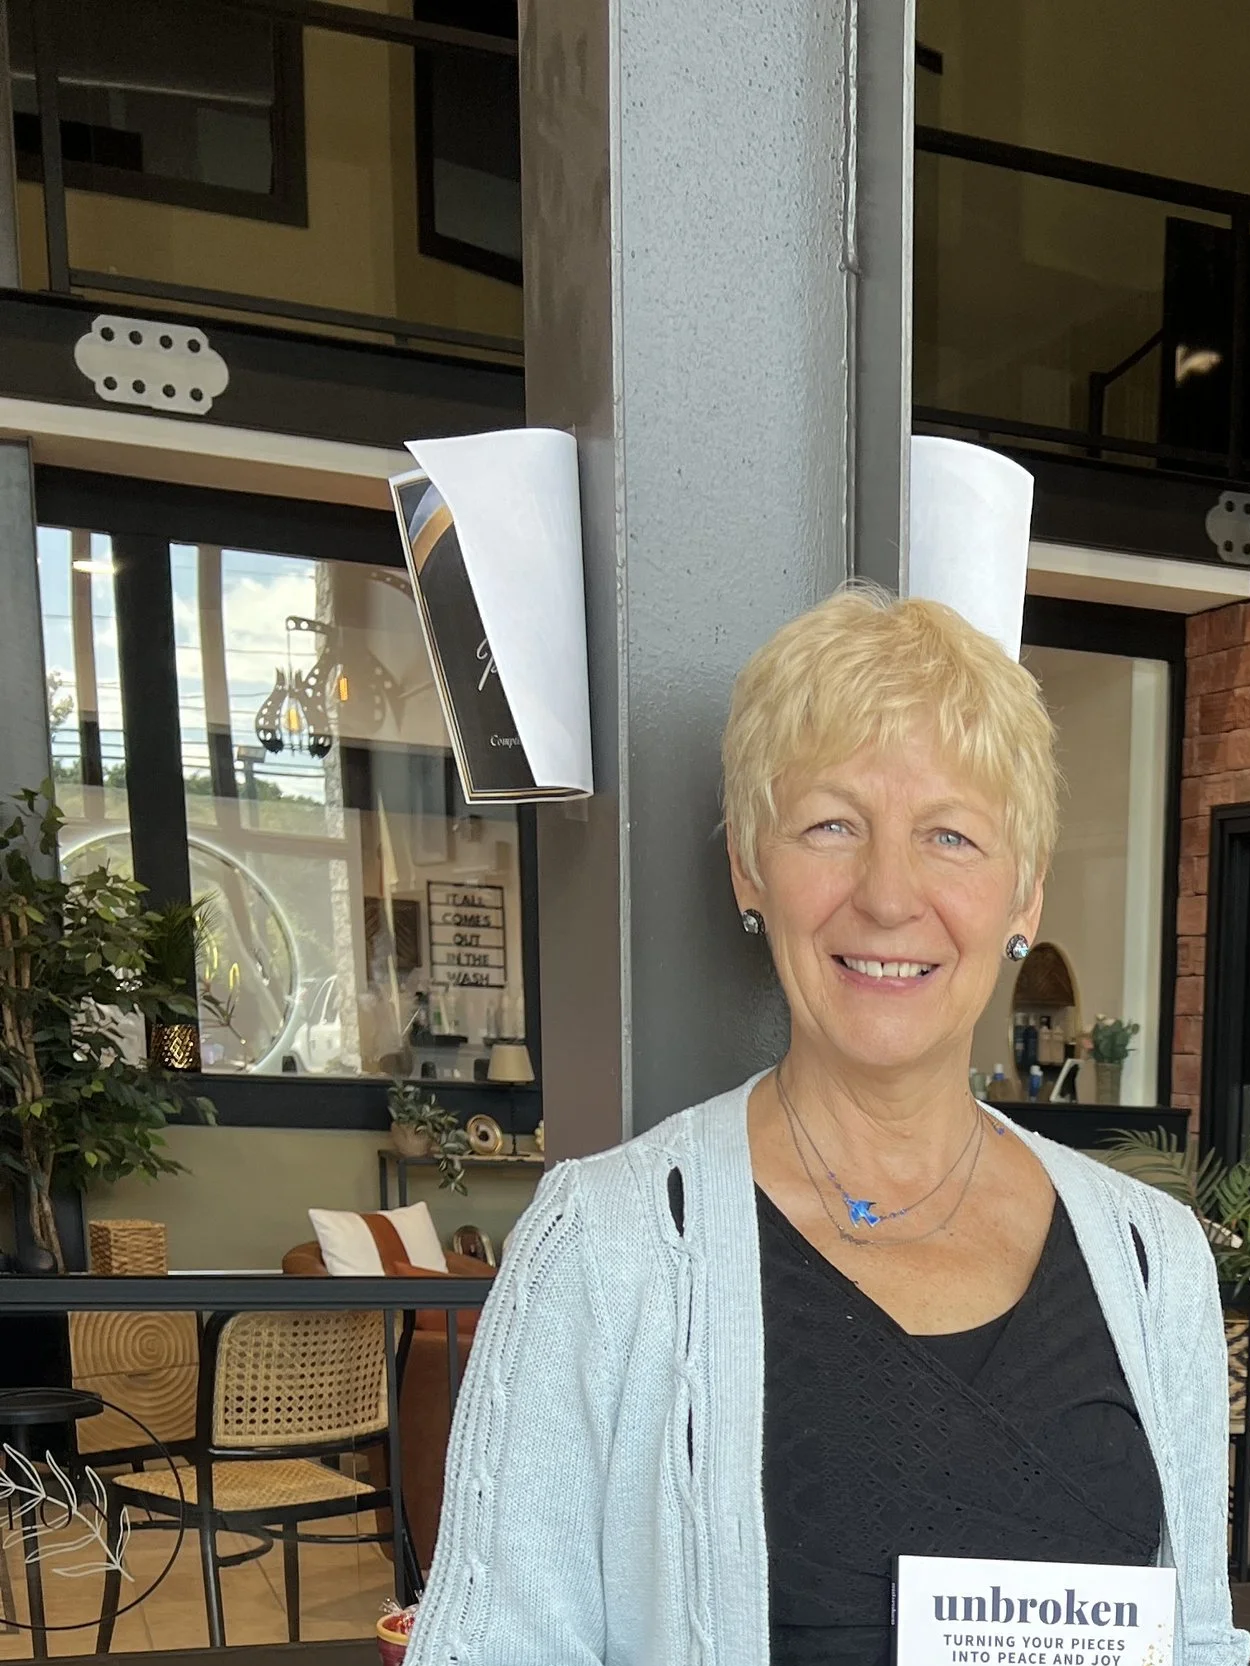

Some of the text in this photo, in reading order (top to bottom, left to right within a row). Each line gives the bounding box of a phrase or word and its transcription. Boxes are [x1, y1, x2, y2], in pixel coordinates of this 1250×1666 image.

[441, 913, 491, 927] COMES
[453, 933, 481, 947] OUT
[447, 971, 490, 985] WASH
[933, 1586, 1139, 1627] unbroken
[943, 1634, 1126, 1651] TURNING YOUR PIECES
[952, 1650, 1121, 1666] INTO PEACE AND JOY
